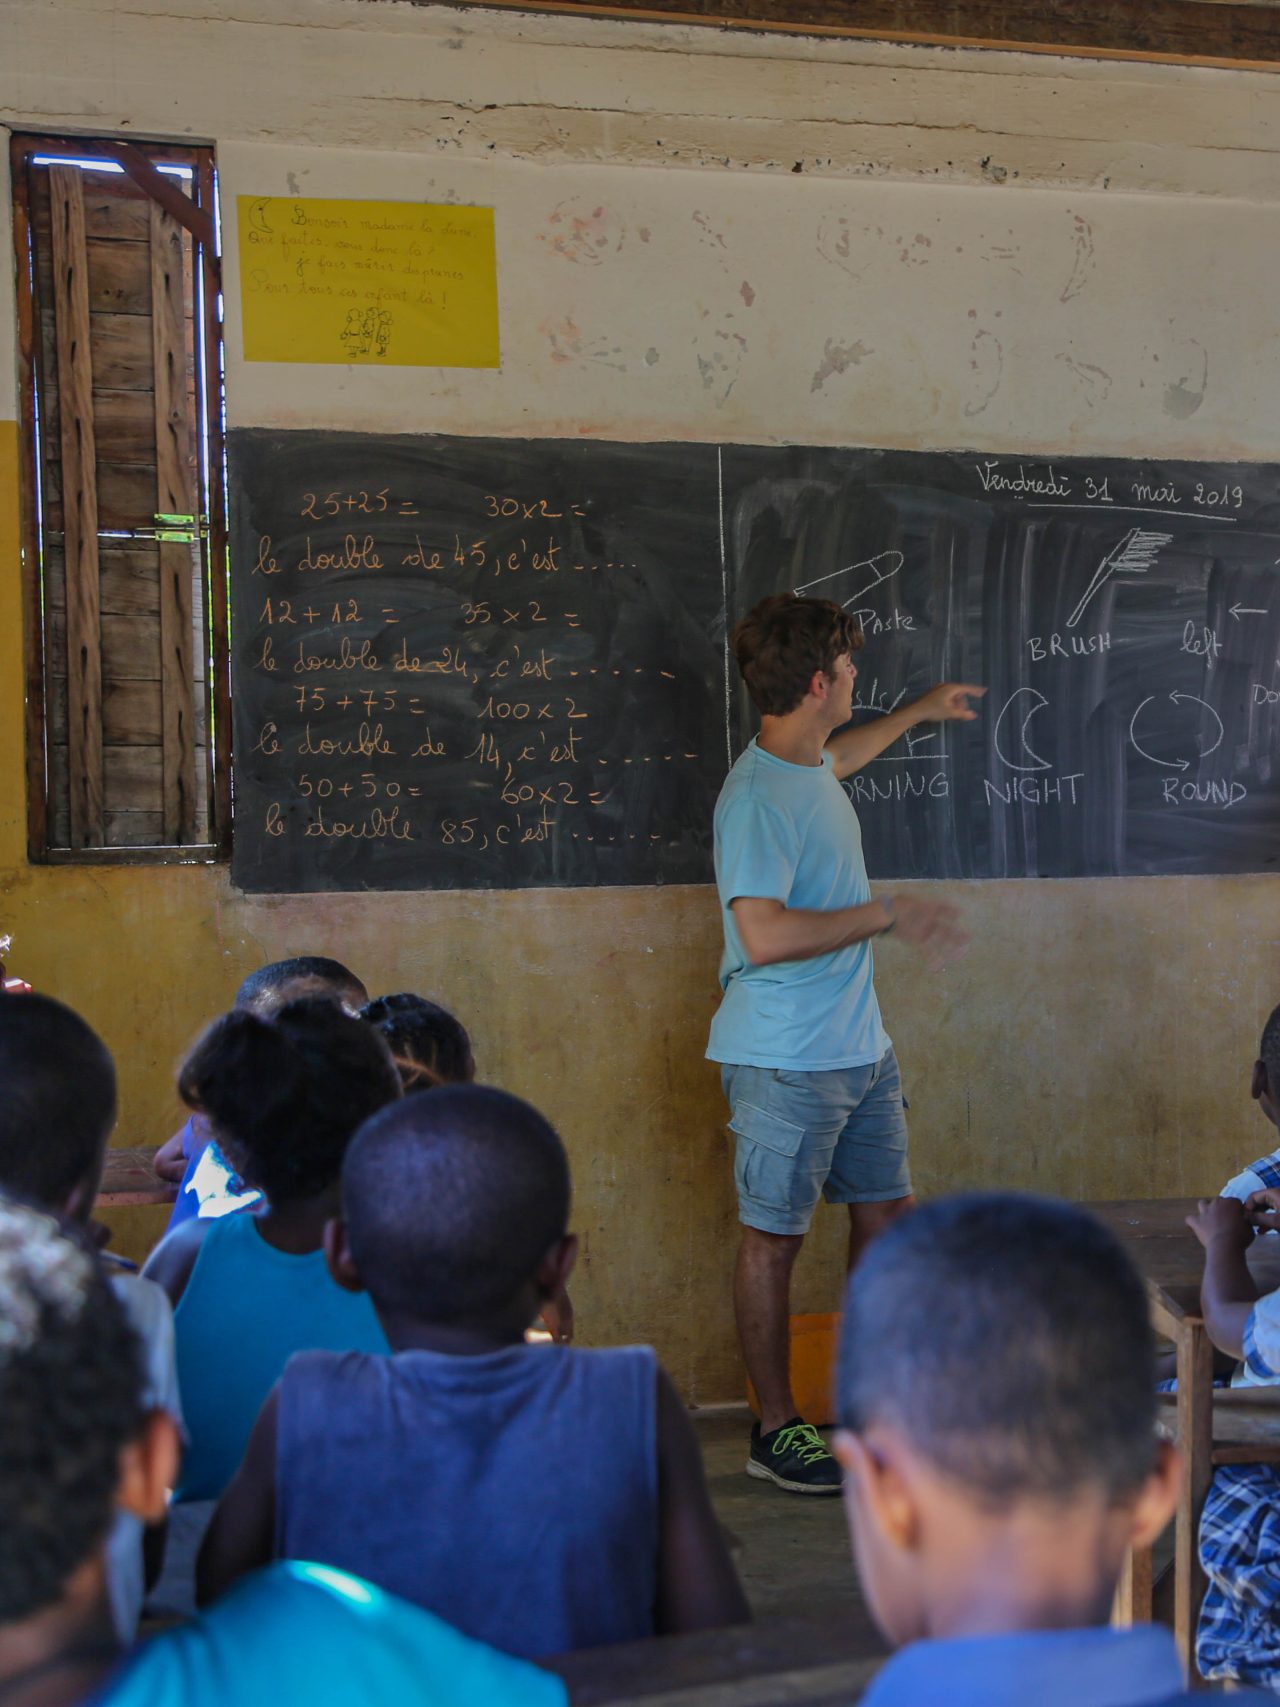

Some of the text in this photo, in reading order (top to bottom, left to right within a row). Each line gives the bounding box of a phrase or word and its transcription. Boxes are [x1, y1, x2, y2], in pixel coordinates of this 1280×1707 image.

[975, 461, 1244, 507] Vendredi 31 mai 2019
[252, 535, 284, 576] le
[297, 535, 386, 572] double
[253, 636, 281, 673] le
[294, 635, 384, 672] double
[298, 721, 397, 756] double
[411, 726, 446, 759] de
[983, 773, 1085, 806] NIGHT
[1162, 777, 1247, 810] ROUND
[264, 803, 287, 838] le
[304, 803, 415, 841] double
